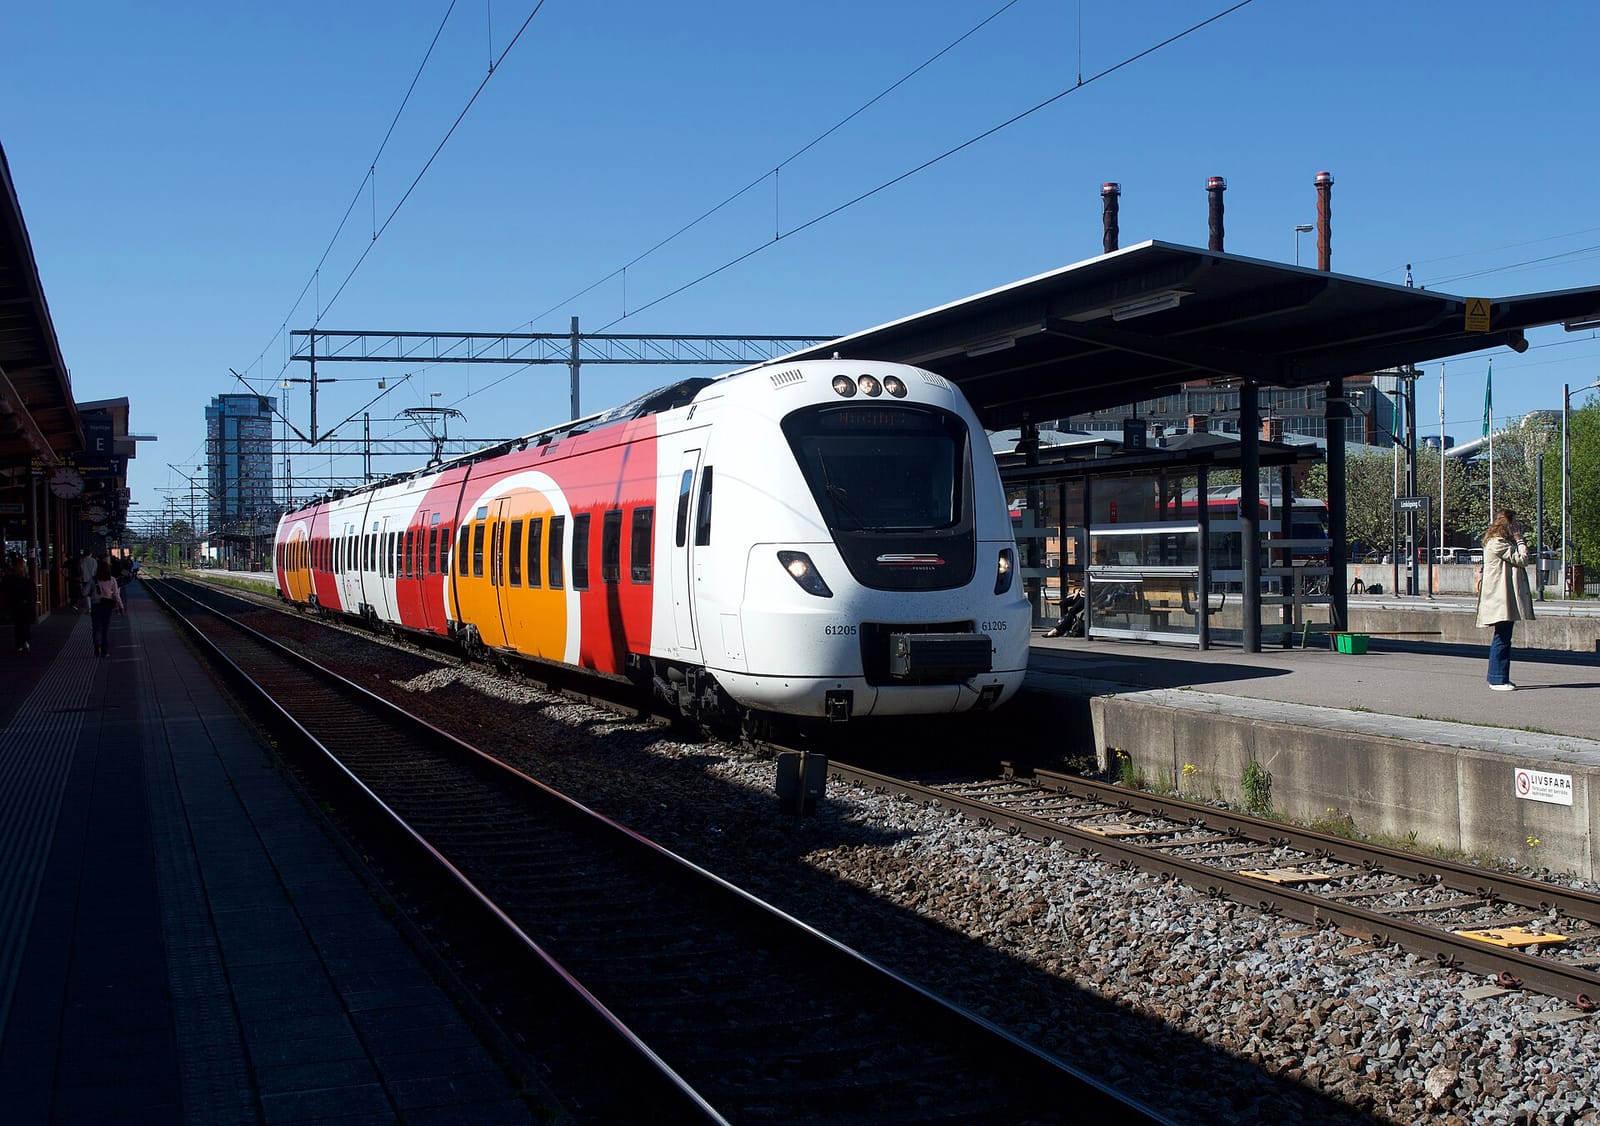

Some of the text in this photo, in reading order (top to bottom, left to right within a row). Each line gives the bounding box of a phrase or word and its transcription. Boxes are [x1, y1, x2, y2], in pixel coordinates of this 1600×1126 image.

[96, 438, 105, 451] E
[825, 625, 857, 635] 61205
[982, 621, 1007, 631] 61205
[1531, 775, 1571, 788] LIVSFARA
